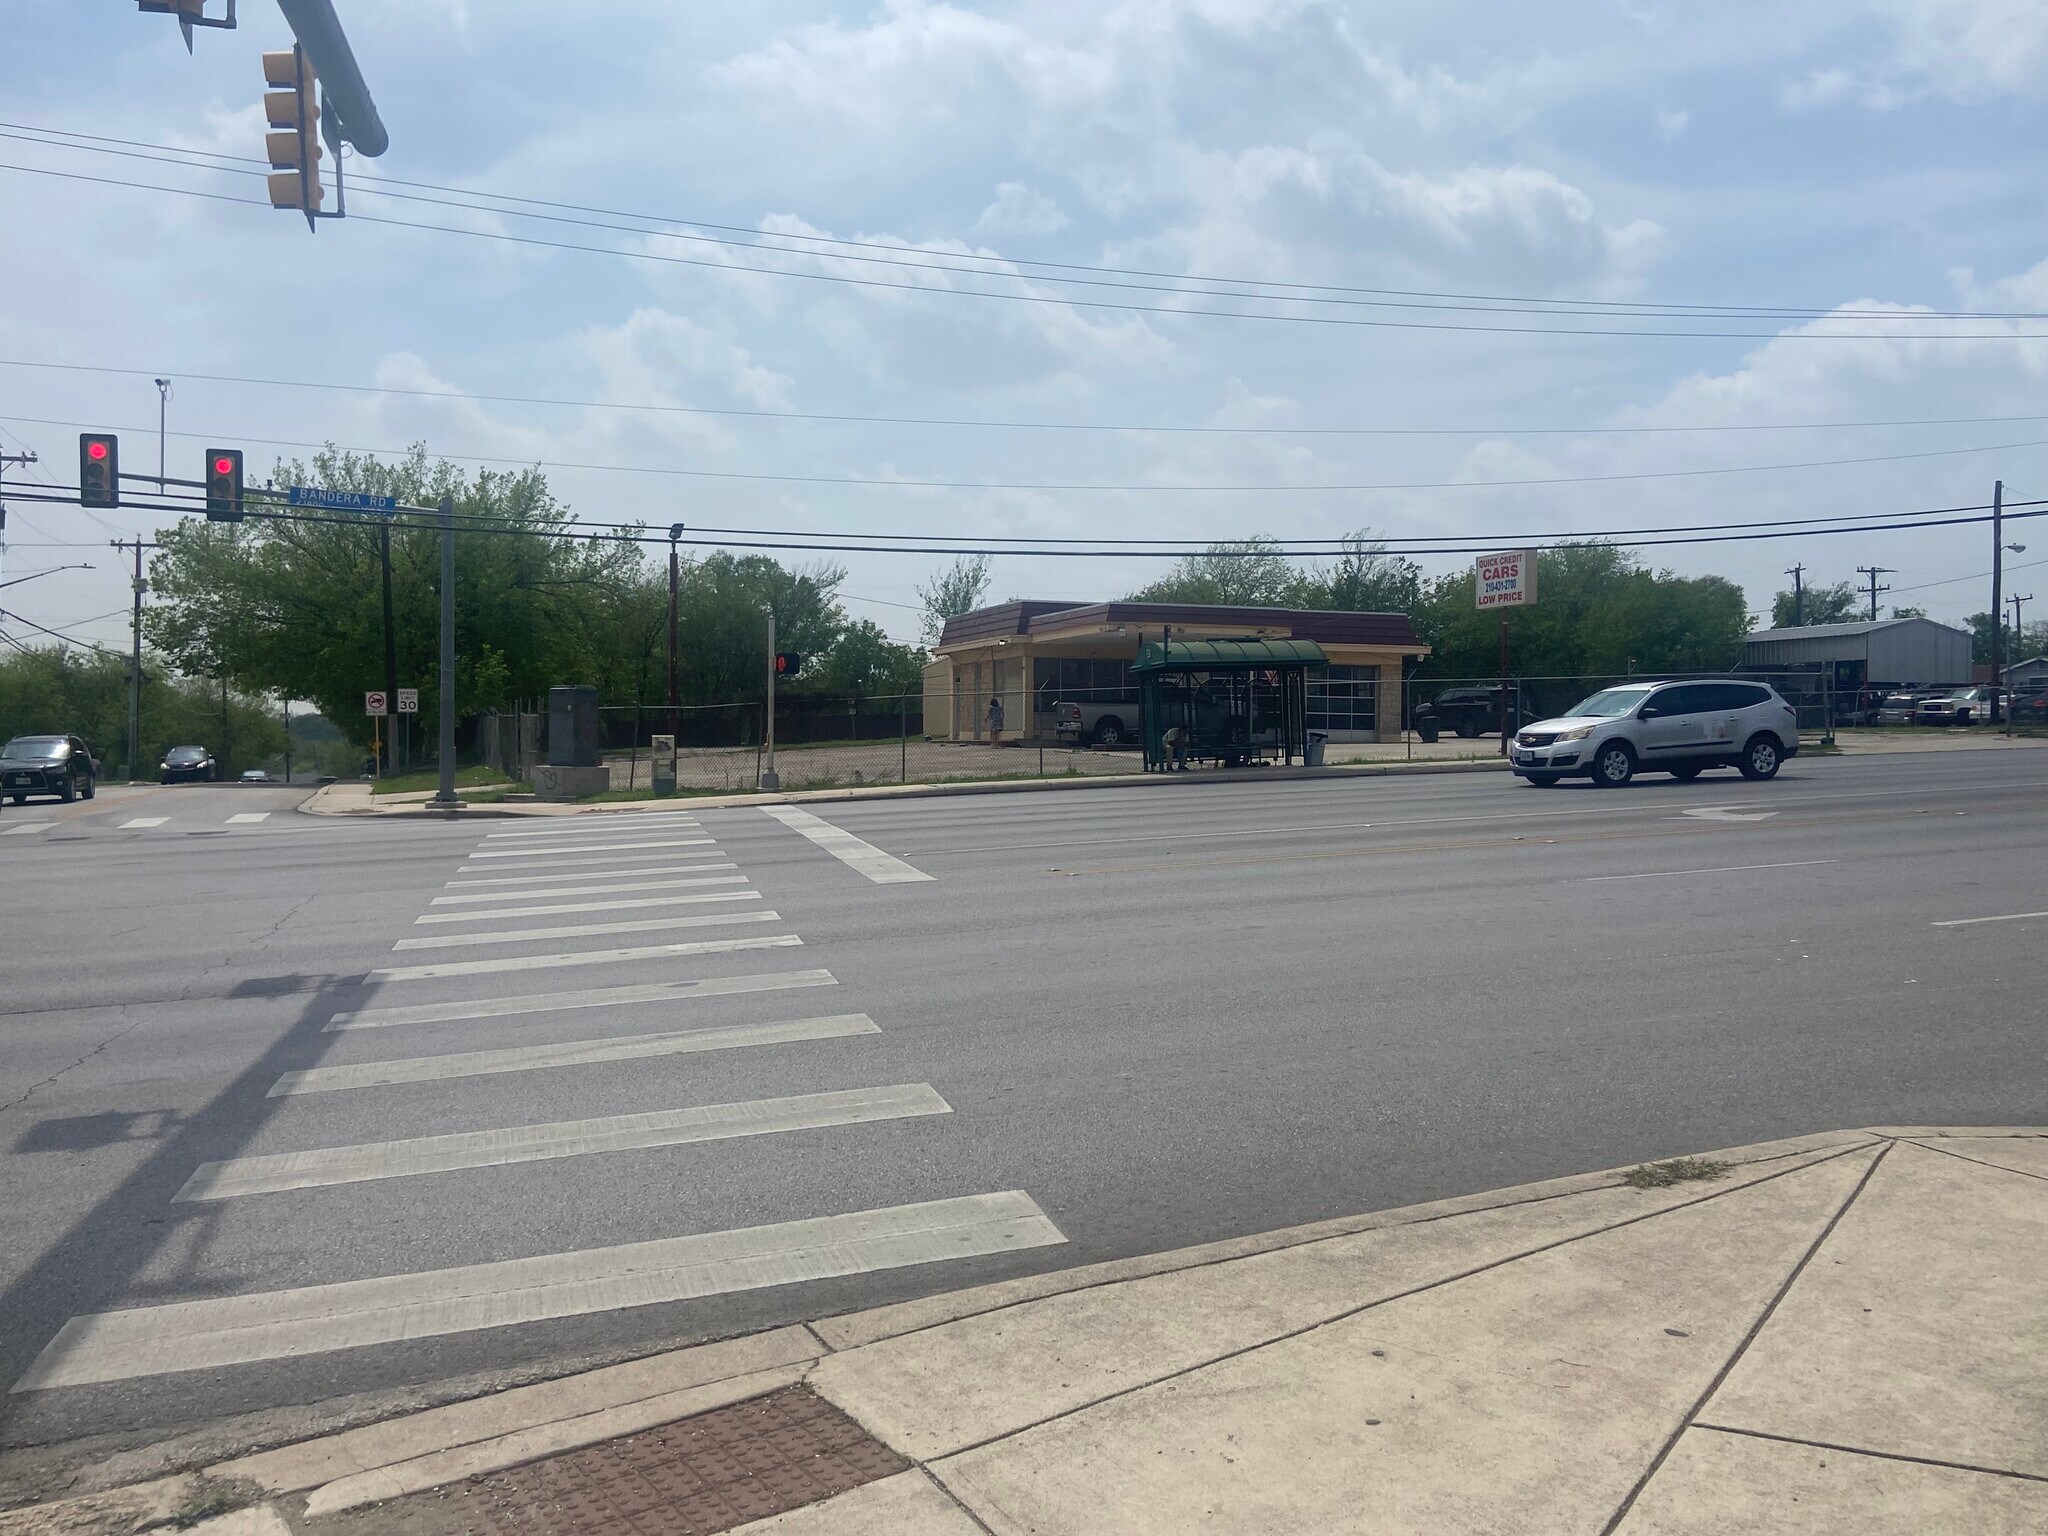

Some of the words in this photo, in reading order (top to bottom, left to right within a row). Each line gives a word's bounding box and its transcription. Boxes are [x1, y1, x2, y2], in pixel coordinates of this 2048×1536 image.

[299, 489, 361, 505] BANDERA
[369, 496, 386, 508] RD
[1479, 558, 1498, 568] QUICK
[1500, 554, 1522, 565] CREDIT
[1483, 564, 1518, 580] CARS
[1479, 595, 1496, 605] LOW
[1498, 591, 1522, 602] PRICE
[400, 701, 416, 710] 30
